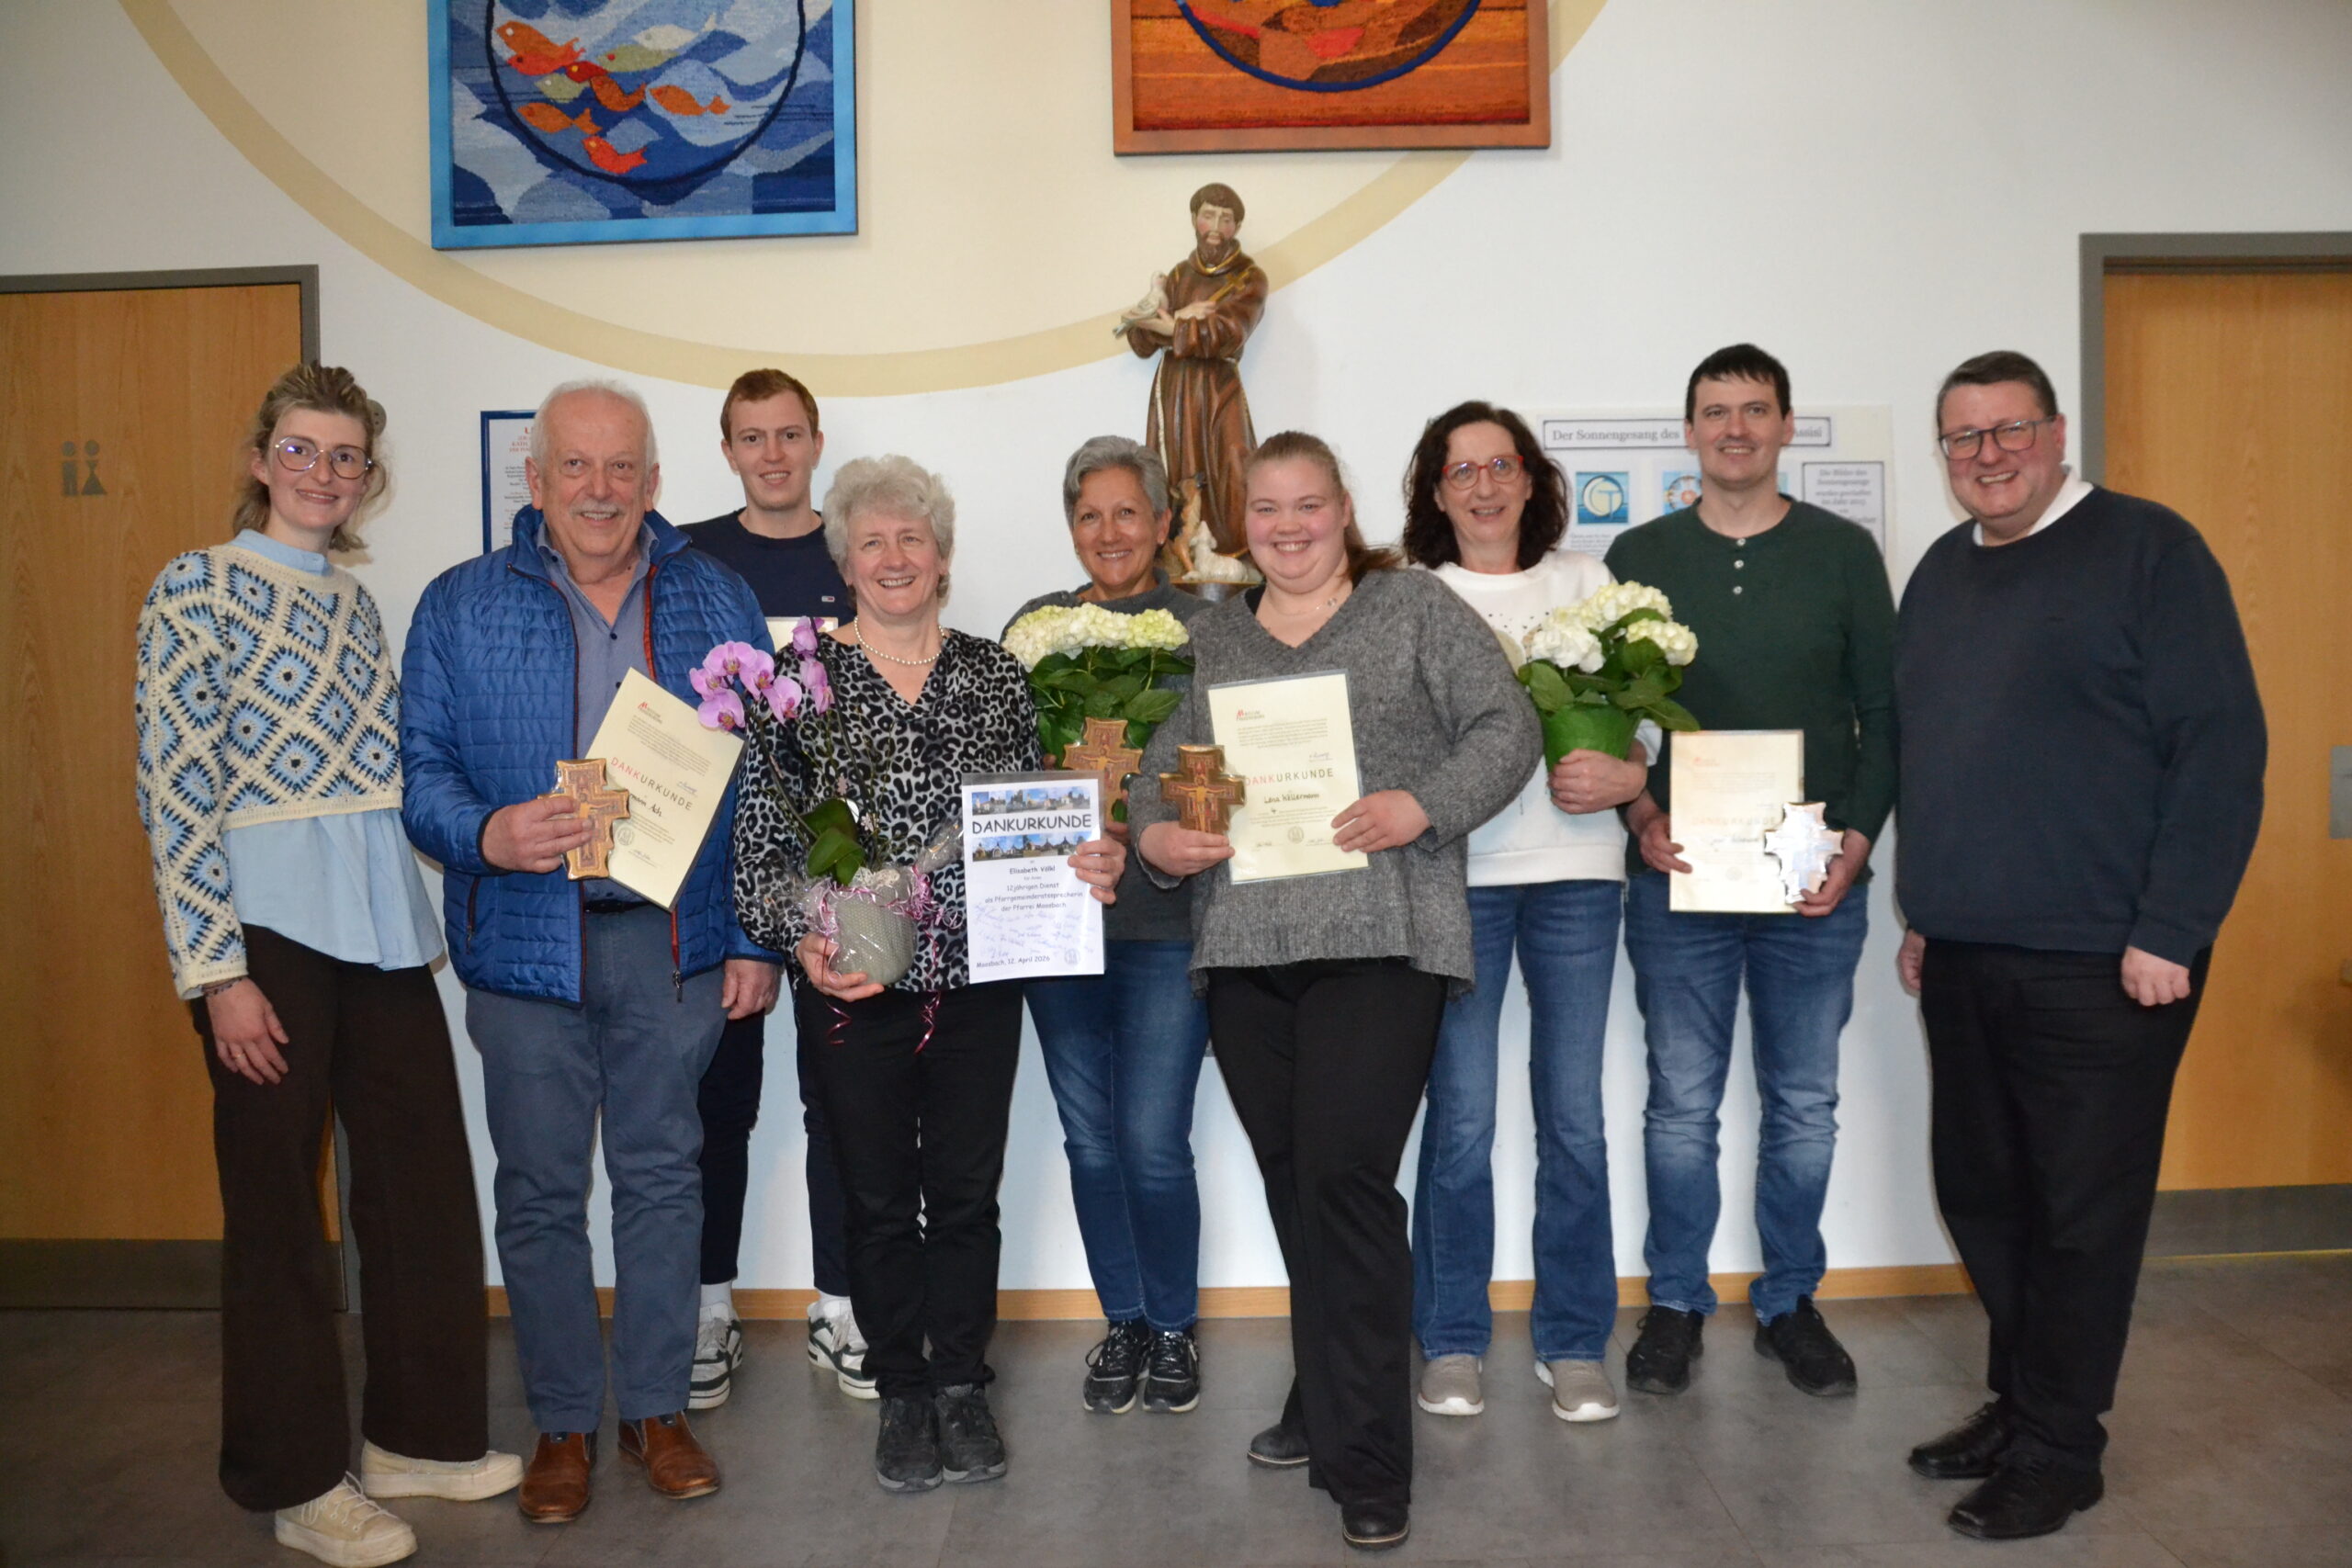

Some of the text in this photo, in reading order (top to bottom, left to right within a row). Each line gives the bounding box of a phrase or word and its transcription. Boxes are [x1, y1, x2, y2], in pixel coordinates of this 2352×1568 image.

[1553, 430, 1573, 441] Der
[1576, 429, 1658, 442] Sonnengesang
[1660, 428, 1680, 439] des
[611, 756, 693, 811] DANKURKUNDE
[1245, 768, 1334, 786] DANKURKUNDE
[972, 814, 1092, 835] DANKURKUNDE
[1018, 956, 1033, 964] April
